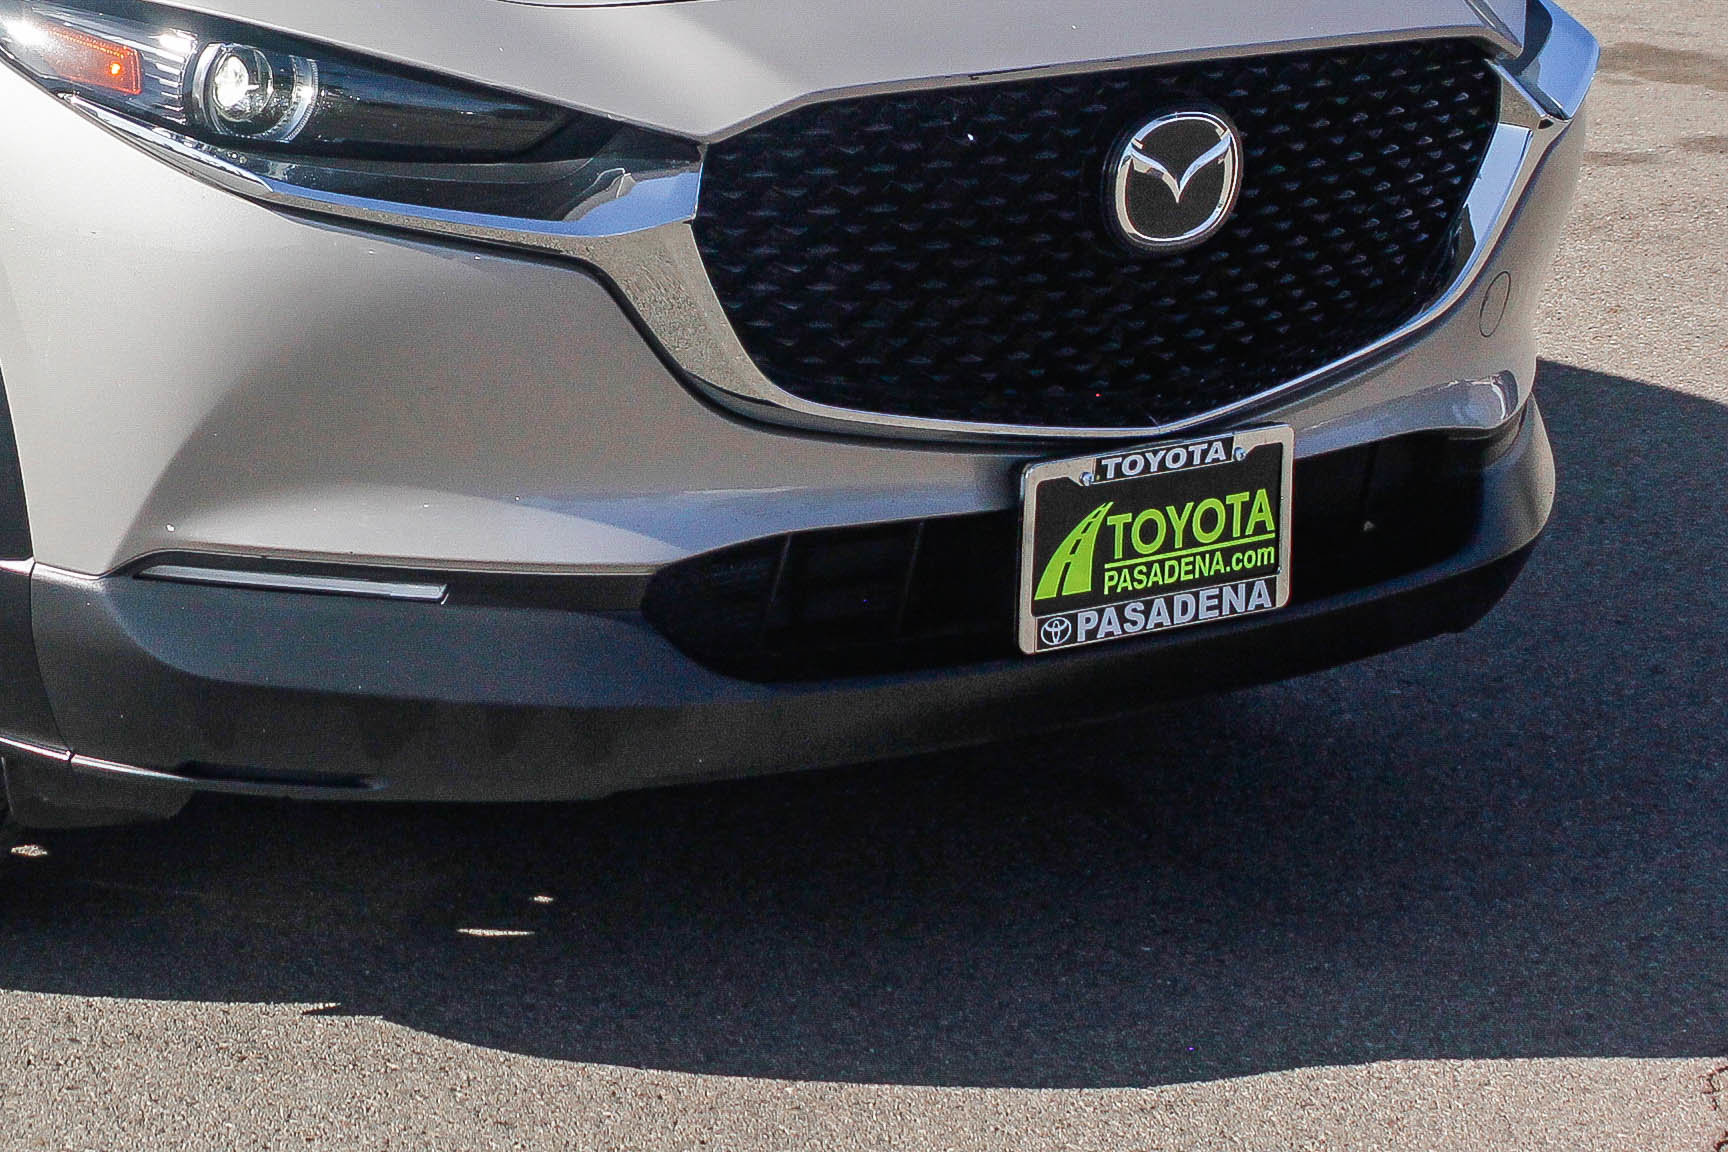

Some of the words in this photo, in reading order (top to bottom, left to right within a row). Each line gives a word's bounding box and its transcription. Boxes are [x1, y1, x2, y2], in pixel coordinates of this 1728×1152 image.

[1101, 441, 1226, 479] TOYOTA
[1106, 488, 1275, 560] TOYOTA
[1103, 546, 1275, 595] PASADENA.com
[1076, 580, 1273, 643] PASADENA
